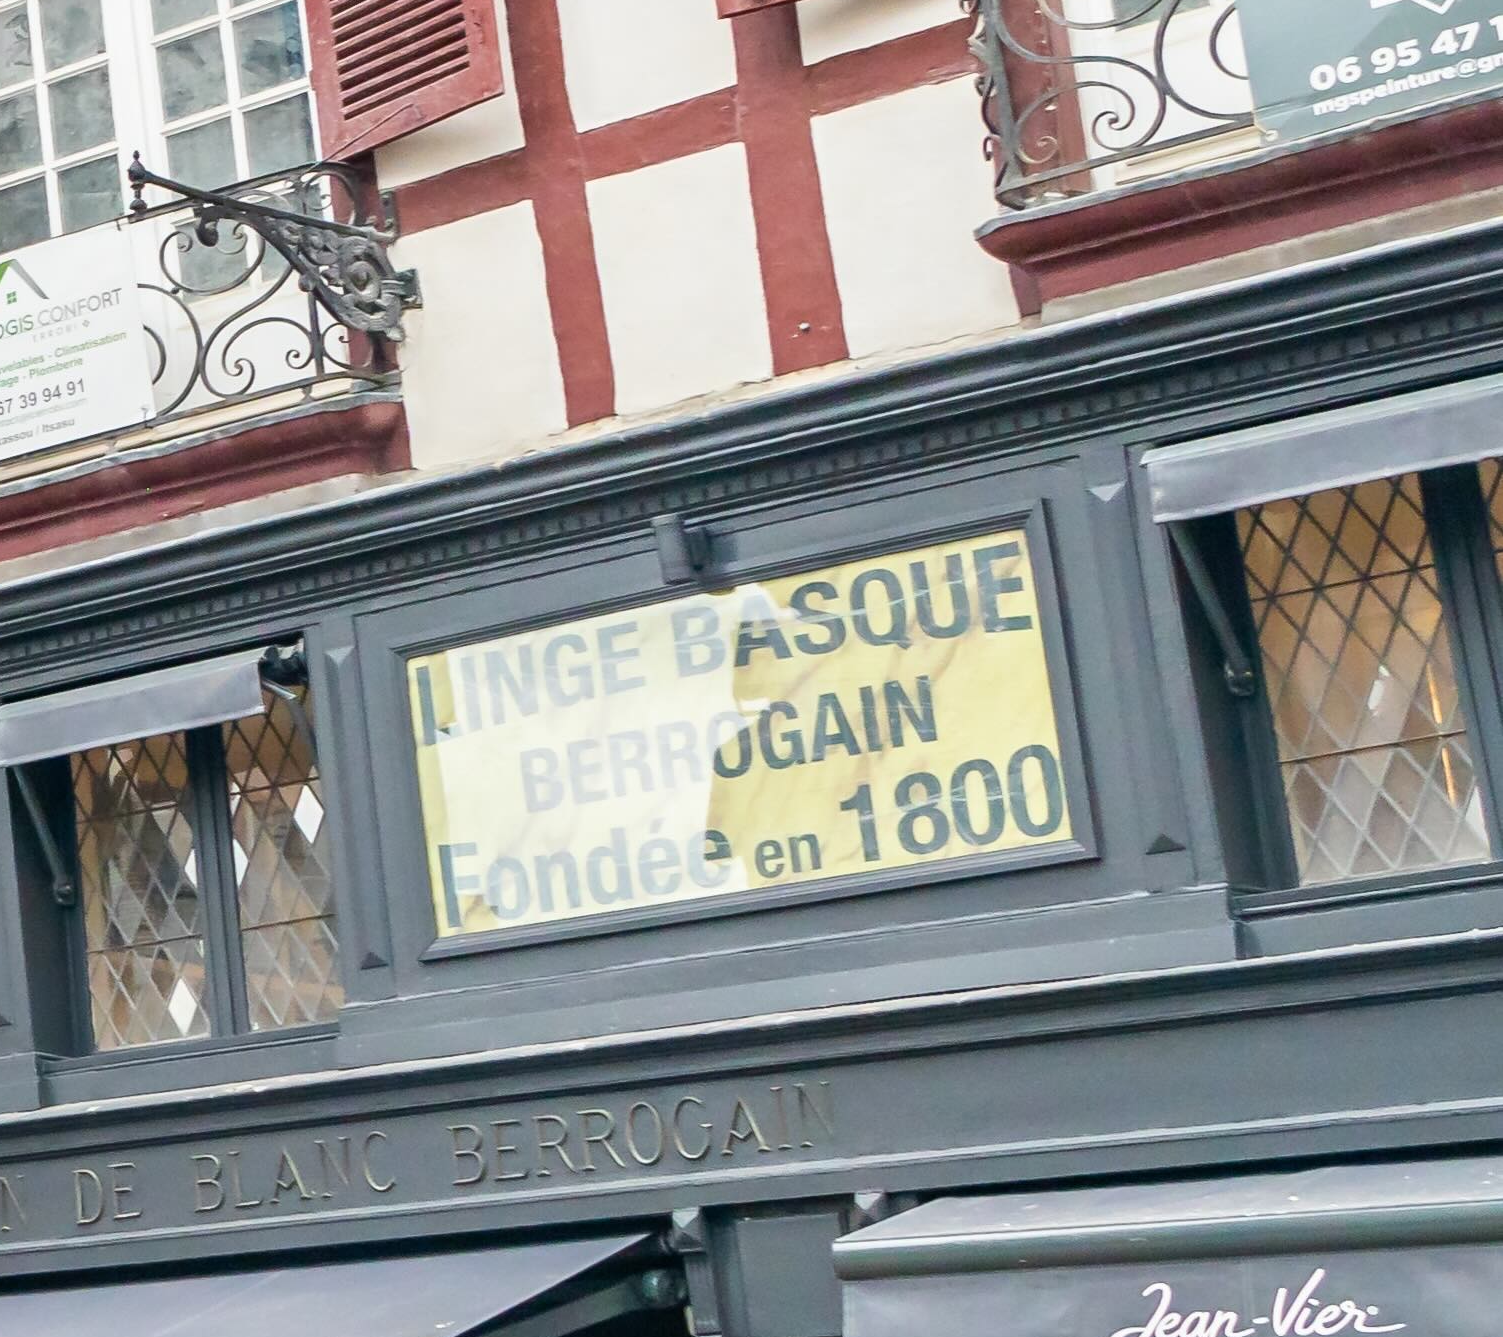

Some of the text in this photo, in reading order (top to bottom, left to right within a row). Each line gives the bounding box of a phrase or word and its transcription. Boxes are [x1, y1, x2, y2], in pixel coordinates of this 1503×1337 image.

[1308, 55, 1363, 92] 06
[1370, 38, 1423, 75] 95
[1430, 21, 1480, 56] 47
[37, 287, 123, 327] CONFORT
[29, 356, 84, 380] Plomberie
[54, 331, 128, 359] Climatisation
[19, 391, 38, 410] 39
[41, 384, 62, 403] 94
[66, 378, 86, 397] 91
[41, 418, 76, 434] Itsasu
[415, 541, 1034, 747] LINGE BASQUE
[519, 674, 940, 815] BERROGAIN
[437, 743, 1065, 929] Fondée en 1800
[72, 1161, 143, 1227] DE
[191, 1130, 398, 1214] BLANC
[445, 1079, 836, 1188] BERROGAIN
